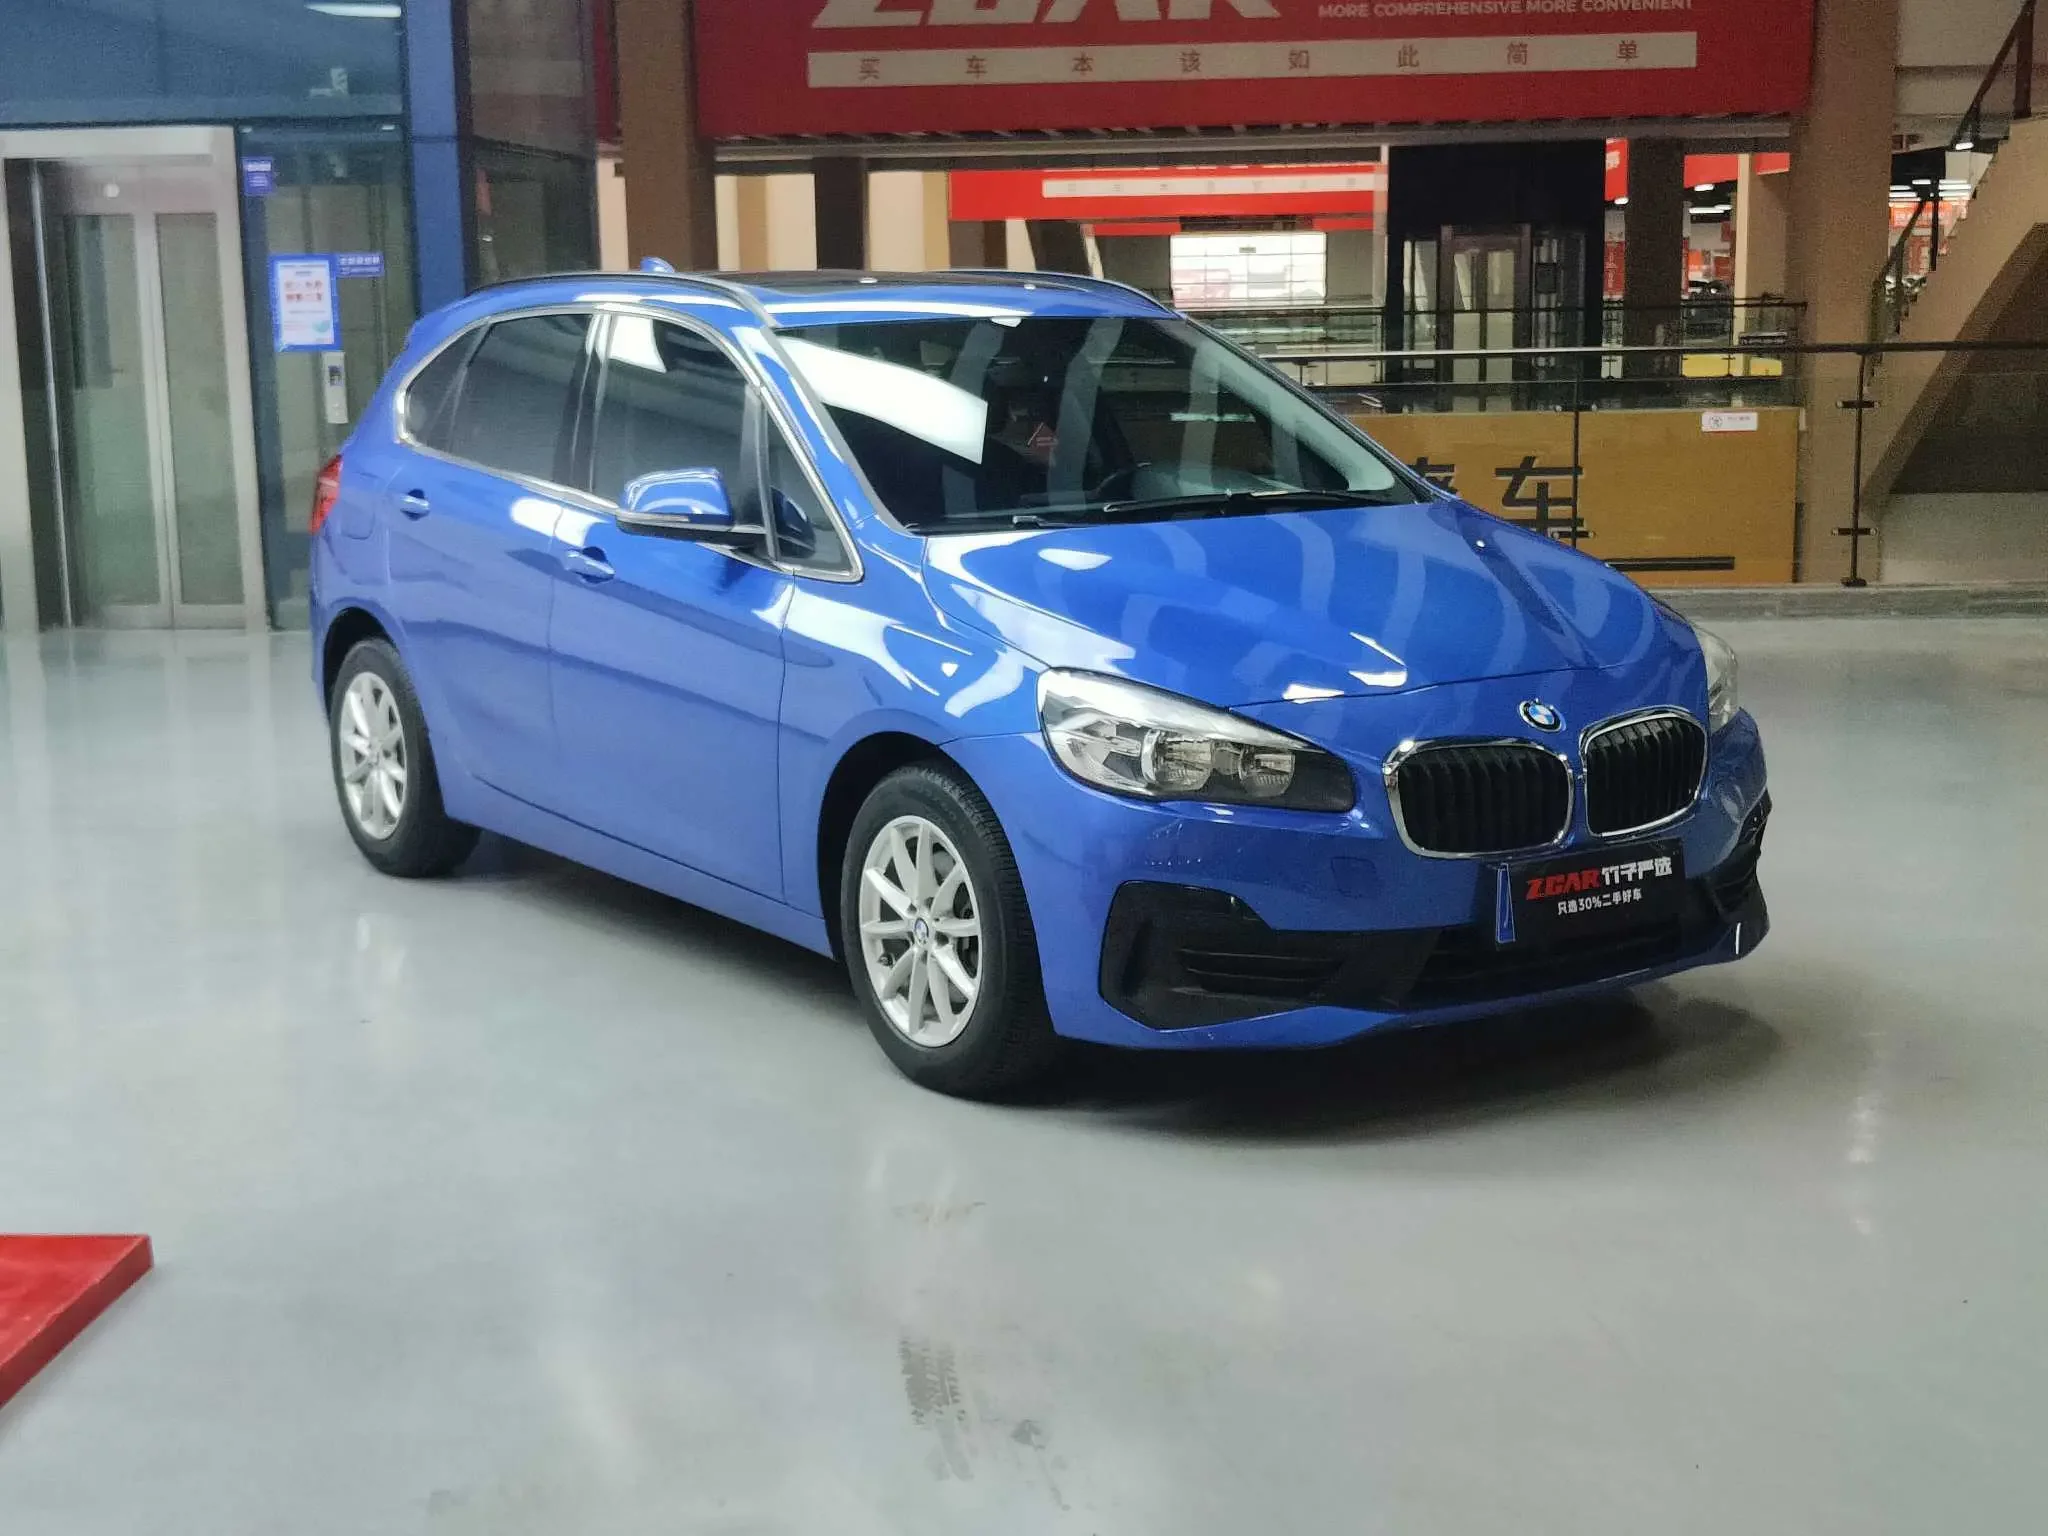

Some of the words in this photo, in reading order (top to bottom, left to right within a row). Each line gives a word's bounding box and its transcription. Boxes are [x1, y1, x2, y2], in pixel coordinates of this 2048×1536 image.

[1318, 4, 1369, 18] MORE
[1373, 1, 1522, 17] COMPREHENSIVE
[1526, 0, 1577, 13] MORE
[1581, 0, 1693, 12] CONVENIENT
[858, 39, 1639, 81] 买车本该如此简单
